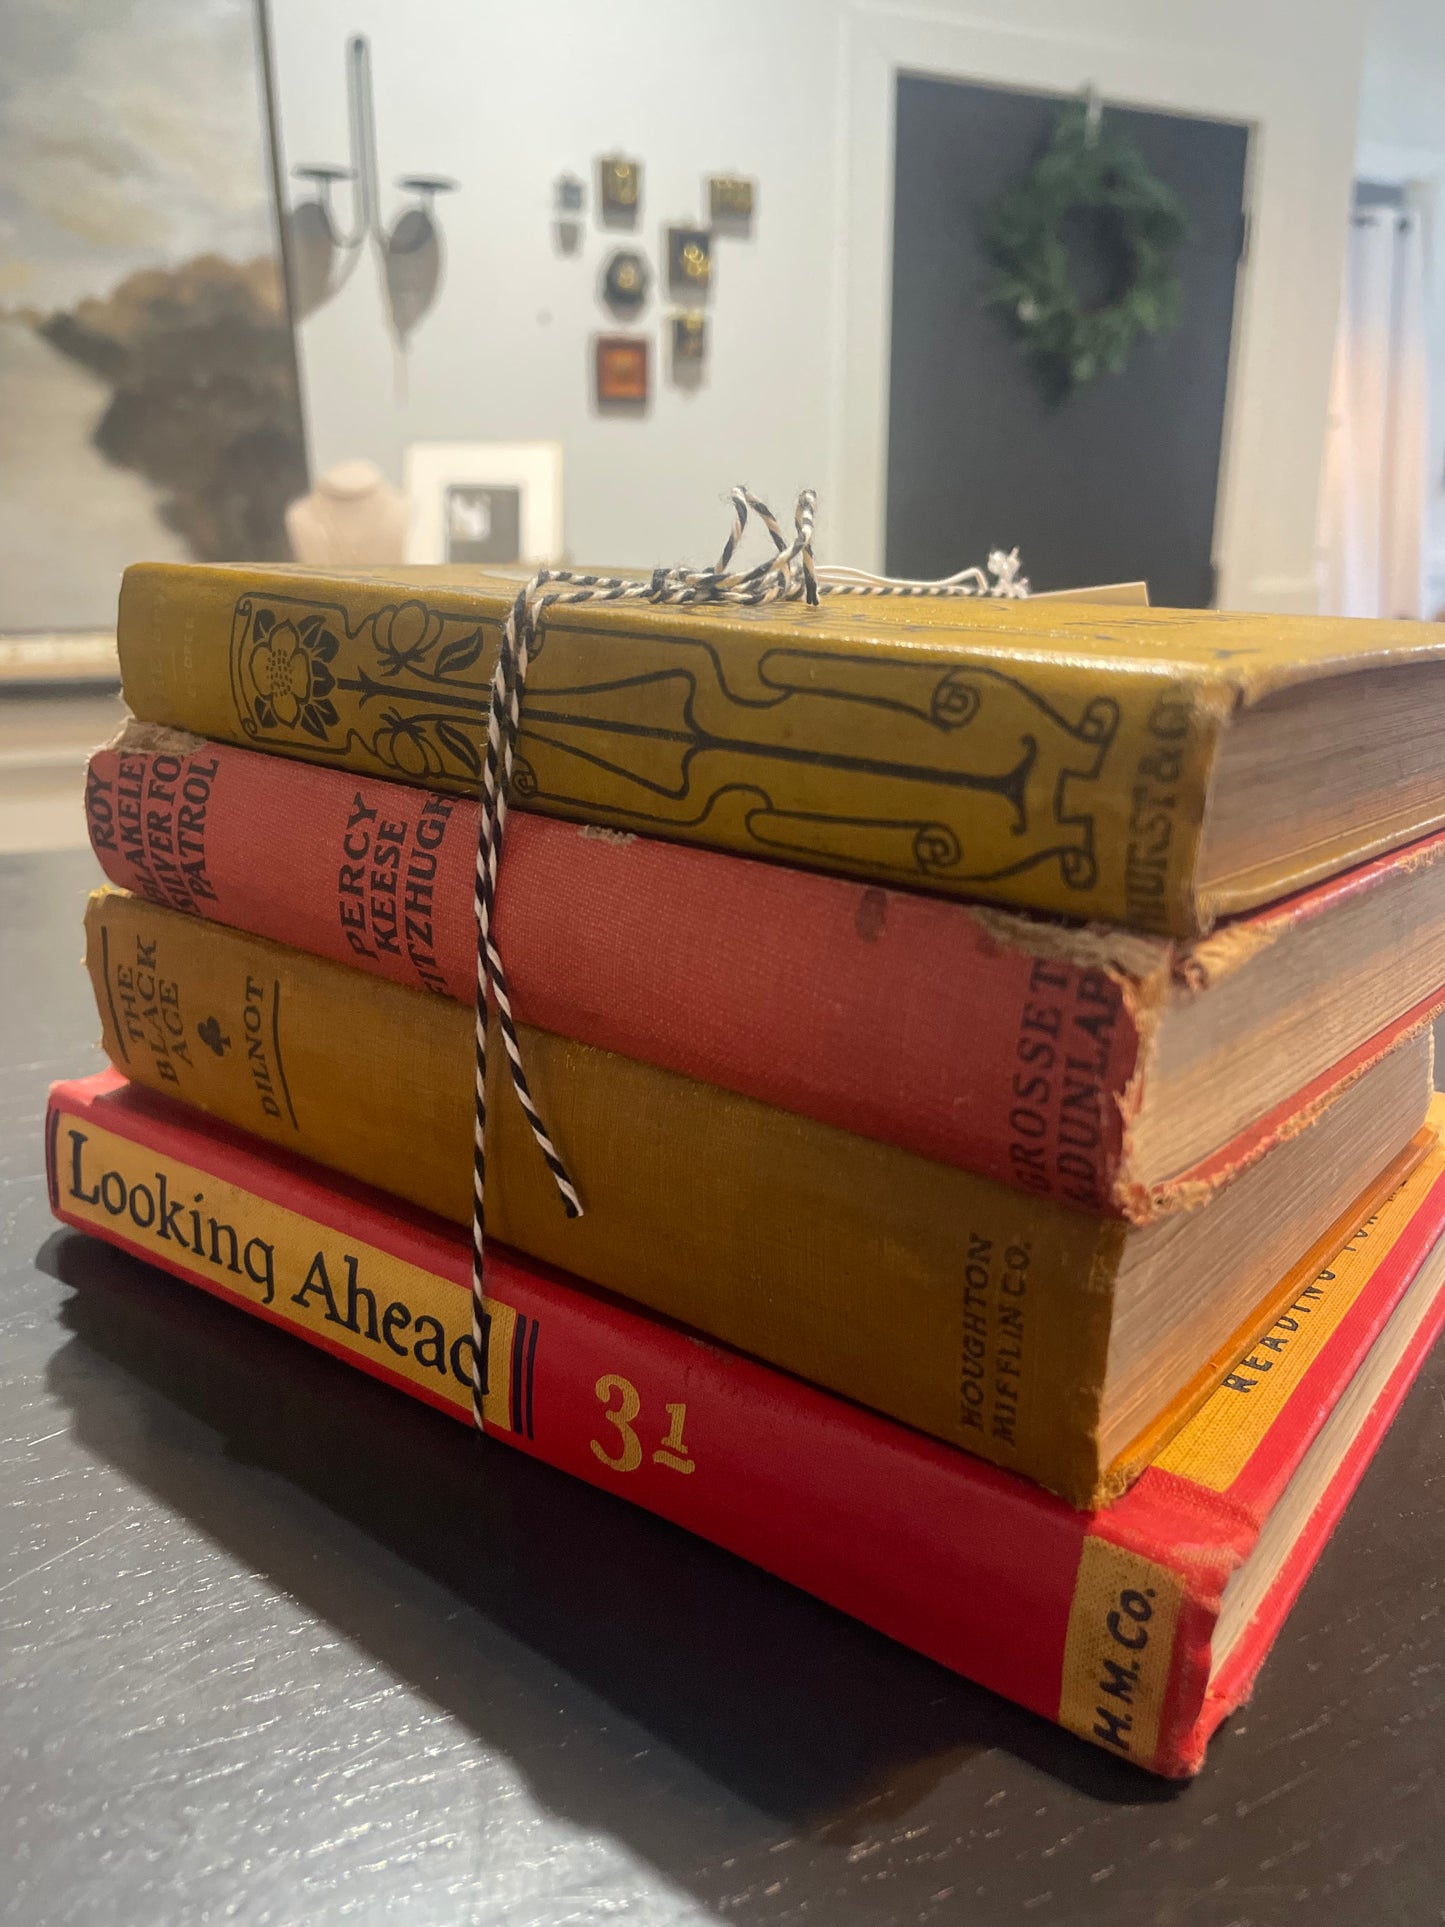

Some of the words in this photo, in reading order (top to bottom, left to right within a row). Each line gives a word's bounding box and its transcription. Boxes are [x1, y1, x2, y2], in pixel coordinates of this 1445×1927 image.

[88, 764, 119, 851] ROY
[147, 752, 185, 806] FO
[178, 758, 220, 901] PATROL
[147, 811, 202, 912] SILVER
[339, 792, 380, 961] PERCY
[371, 820, 417, 957] KEESE
[117, 963, 145, 1044] THE
[136, 934, 181, 1087] BLACK
[158, 979, 194, 1069] ACE
[243, 975, 282, 1119] DILNOT
[1056, 967, 1119, 1183] DUNLAP
[66, 1129, 276, 1304] Looking
[291, 1249, 492, 1396] Ahead
[959, 1232, 995, 1434] HOUGHTON
[992, 1305, 1025, 1448] MIFFLIN
